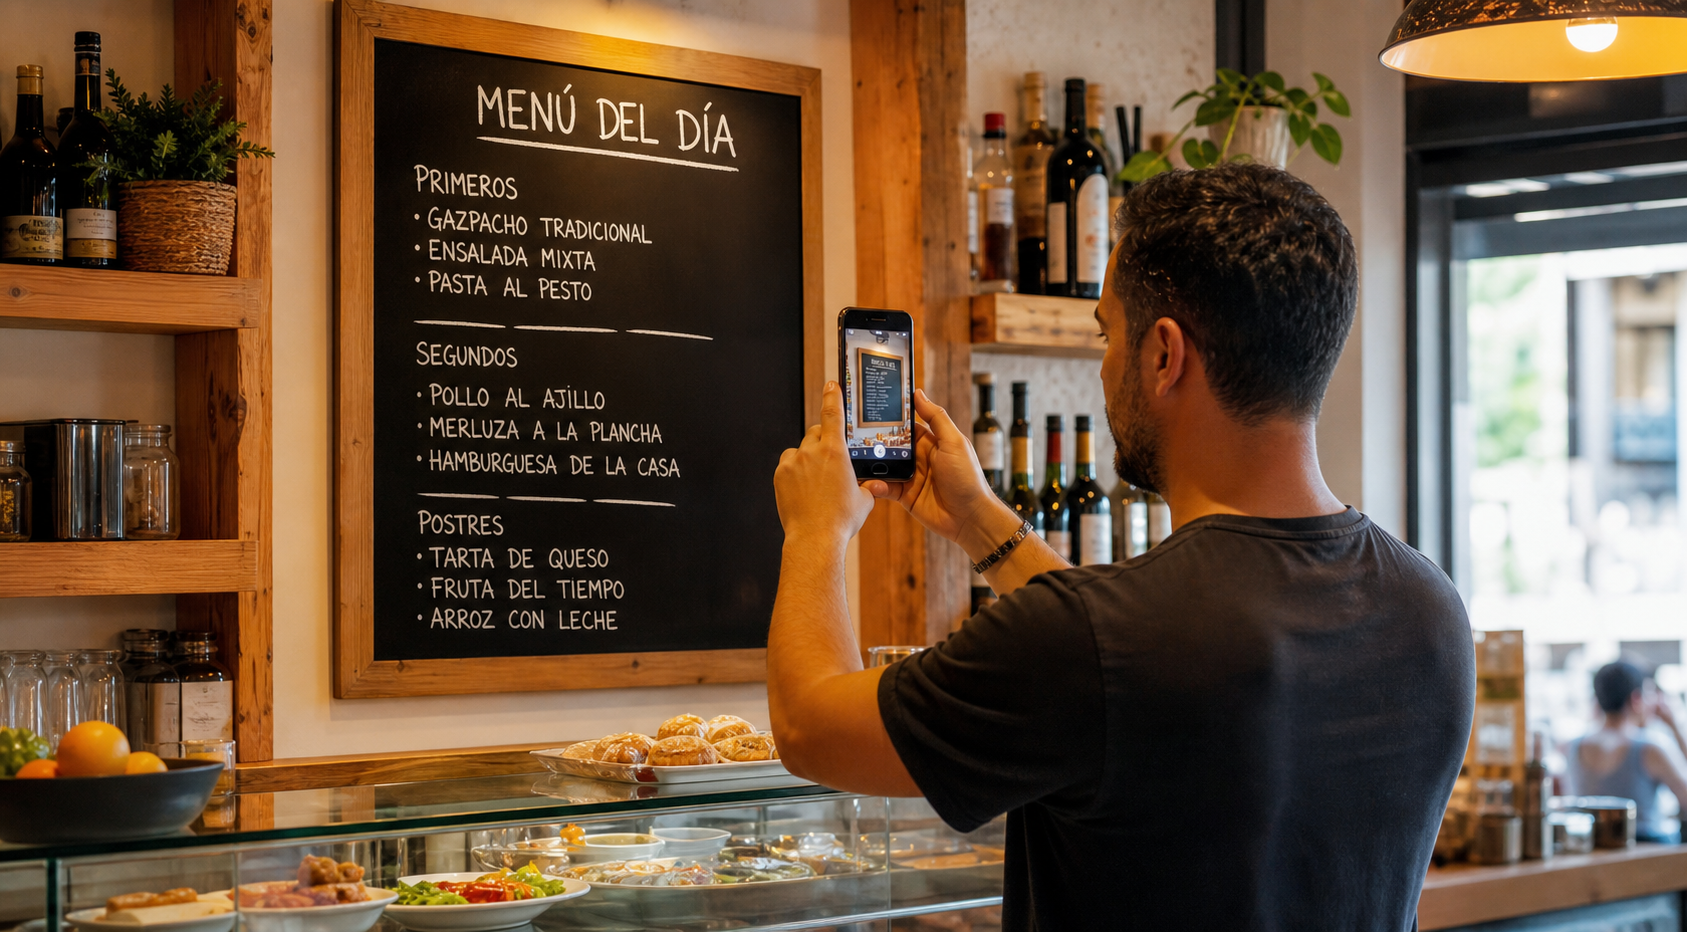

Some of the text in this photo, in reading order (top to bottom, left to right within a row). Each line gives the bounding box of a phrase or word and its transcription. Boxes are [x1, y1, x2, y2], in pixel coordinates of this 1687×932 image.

[478, 83, 737, 158] MENÚ DEL DÍA
[414, 165, 517, 200] PRIMEROS
[428, 207, 653, 244] GAZPACHO TRADICIONAL
[429, 239, 596, 271] ENSALADA MIXTA
[428, 270, 592, 301] PASTA AL PESTO
[416, 342, 518, 368] SEGUNDOS
[429, 383, 490, 408] POLLO
[504, 387, 531, 408] AL
[430, 417, 663, 444] MERLUZA A LA PLANCHA
[429, 450, 681, 478] HAMBURGUESA DE LA CASA
[417, 510, 504, 536] POSTRES
[429, 547, 609, 570] TARTA DE QUESO
[431, 576, 495, 599] FRUTA
[508, 579, 546, 600] DEL
[430, 607, 618, 631] ARROZ CON LECHE
